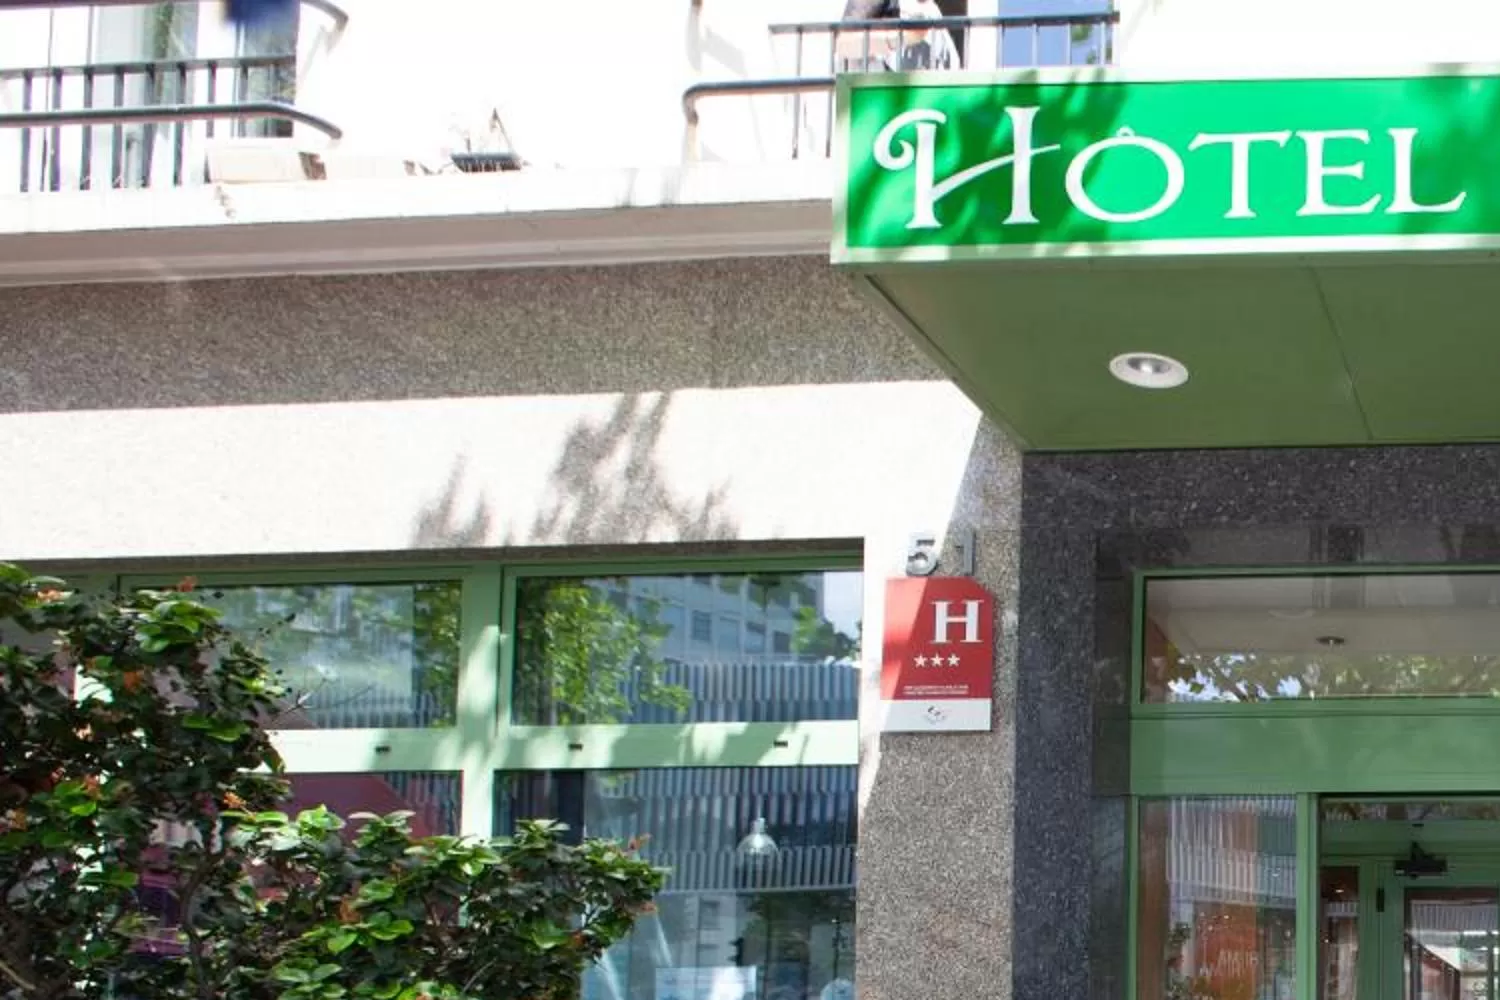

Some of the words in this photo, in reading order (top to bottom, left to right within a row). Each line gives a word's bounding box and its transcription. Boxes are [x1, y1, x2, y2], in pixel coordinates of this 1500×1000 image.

[872, 105, 1467, 229] HÔTEL
[905, 528, 976, 577] 51
[930, 600, 985, 644] H
